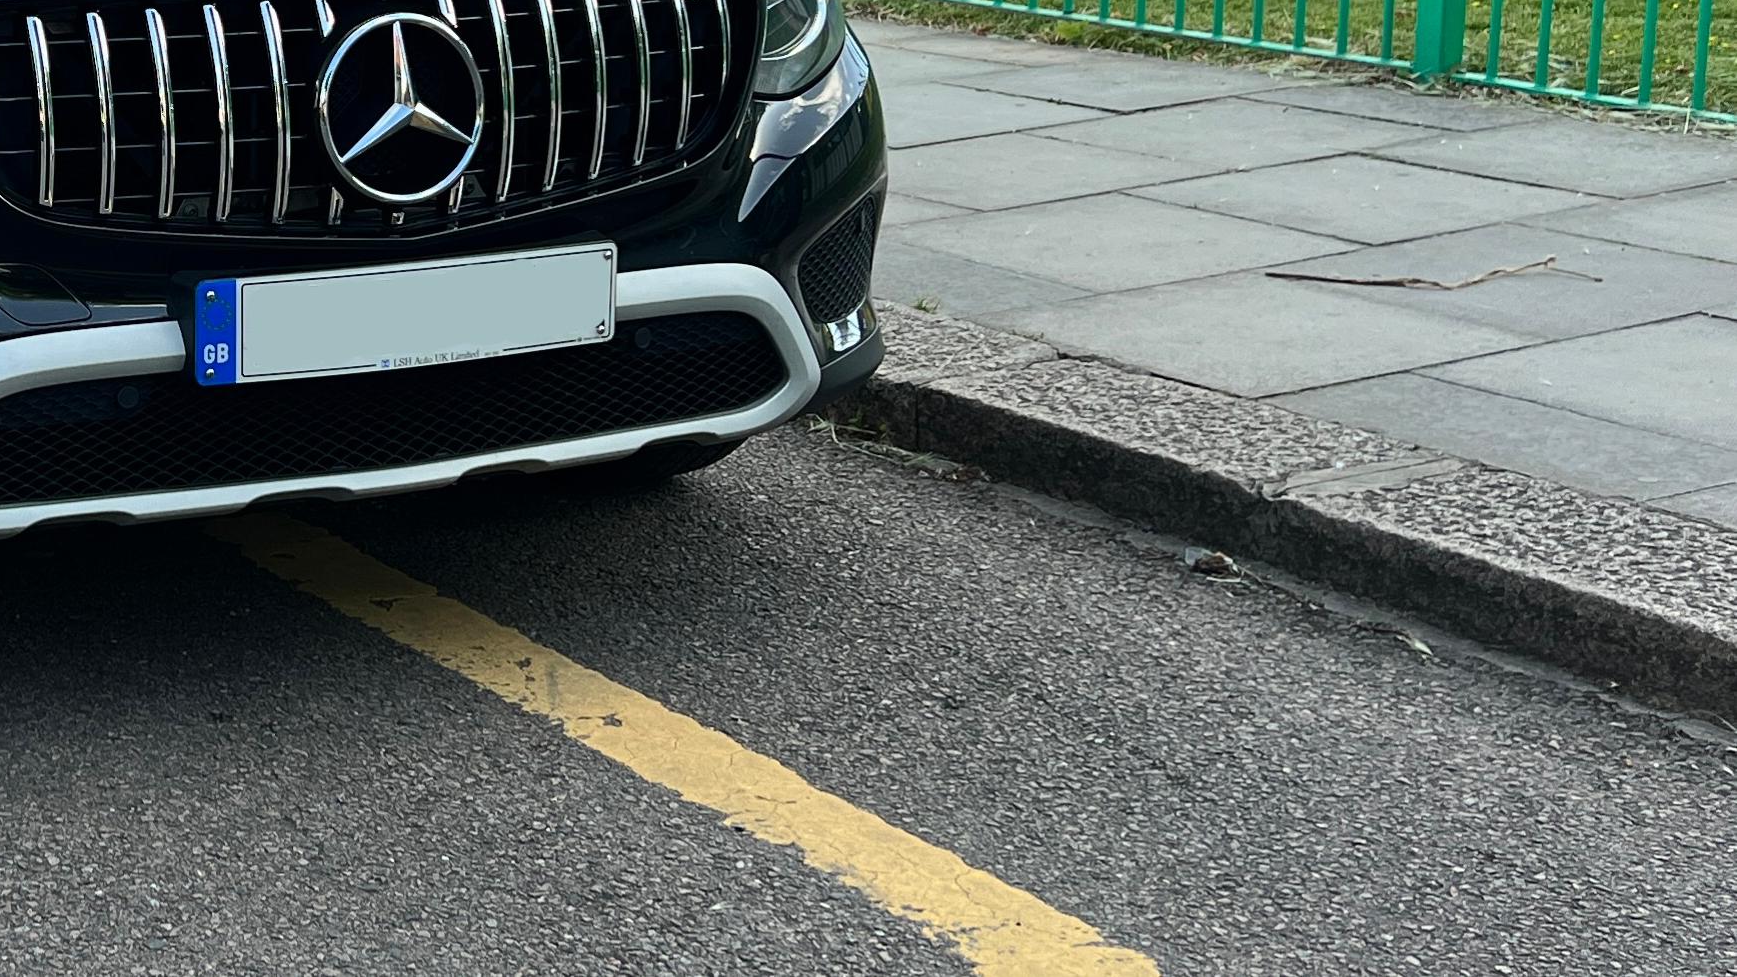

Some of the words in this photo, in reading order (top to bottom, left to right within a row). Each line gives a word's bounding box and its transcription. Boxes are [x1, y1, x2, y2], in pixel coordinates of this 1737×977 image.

[203, 342, 229, 364] GB
[393, 356, 412, 368] LSH
[414, 356, 433, 365] Auto
[435, 353, 449, 363] UK
[450, 349, 480, 361] Limited
